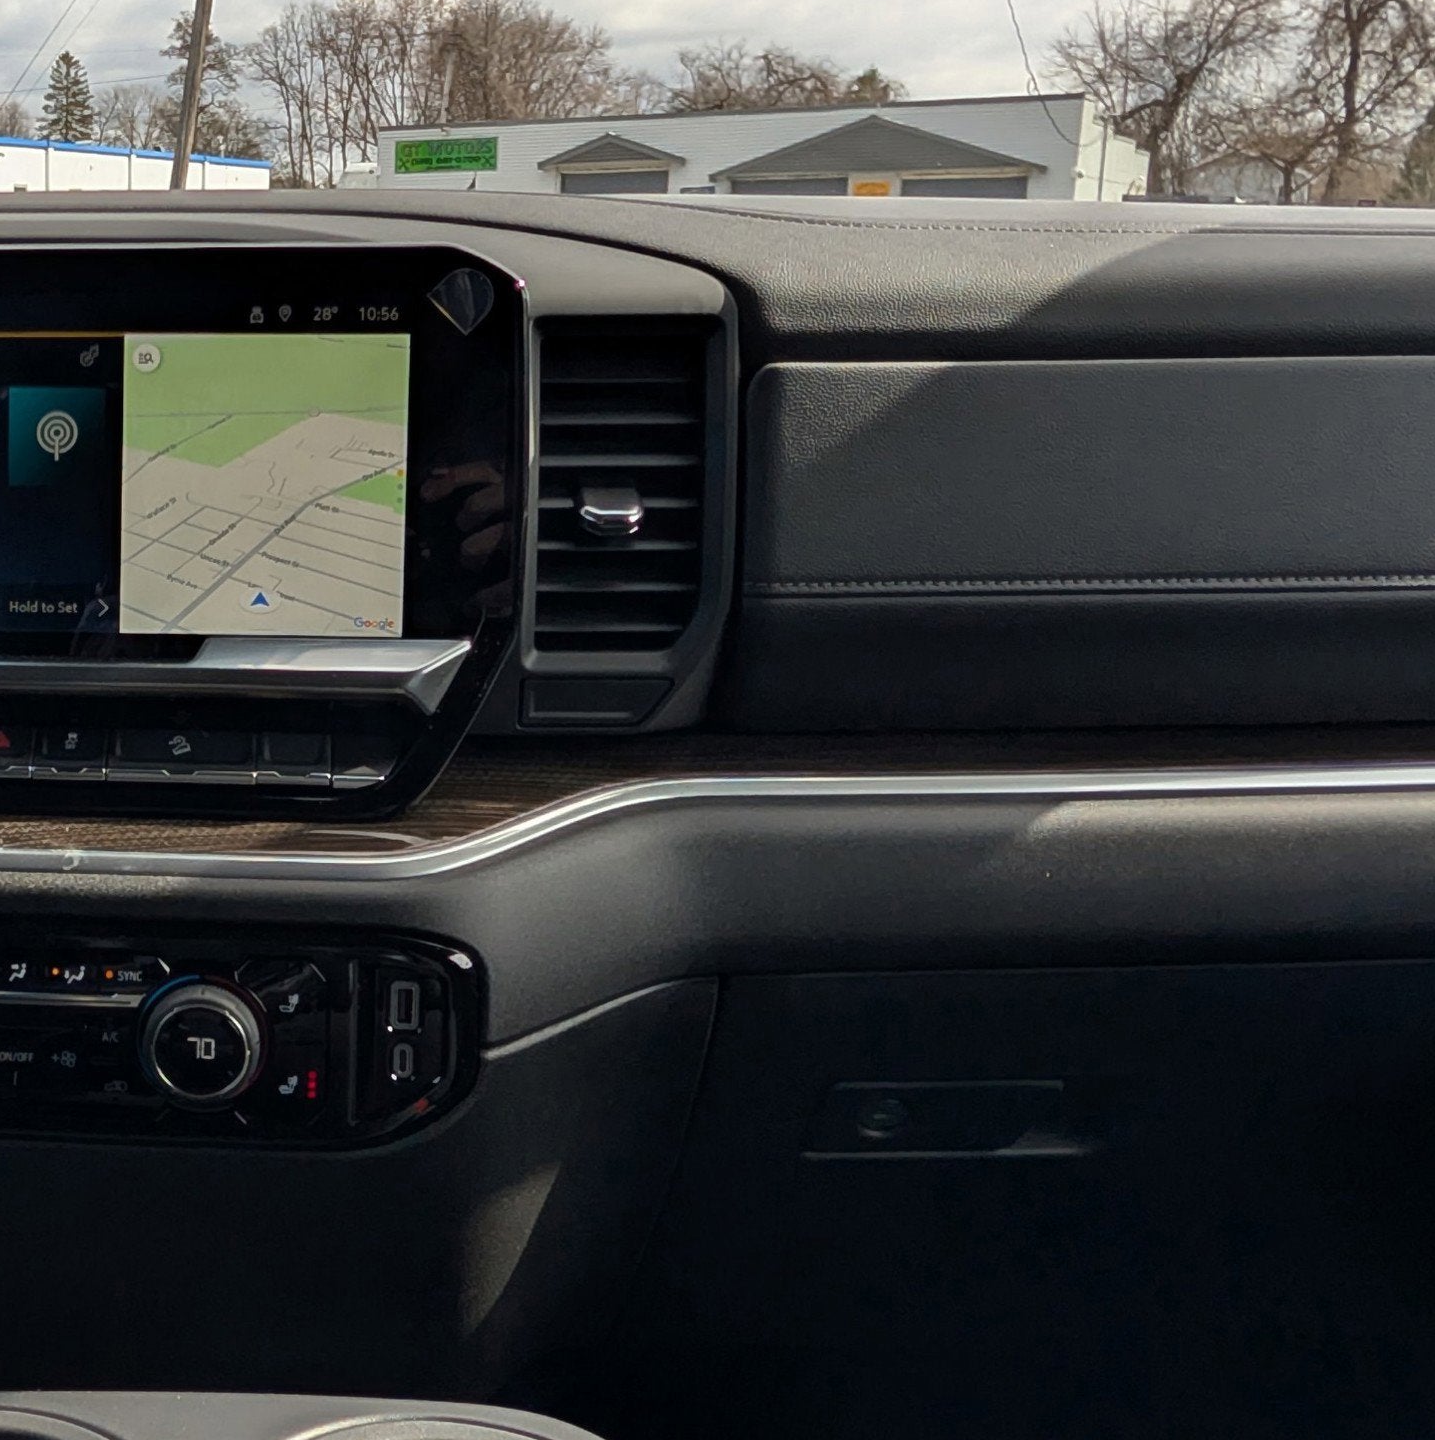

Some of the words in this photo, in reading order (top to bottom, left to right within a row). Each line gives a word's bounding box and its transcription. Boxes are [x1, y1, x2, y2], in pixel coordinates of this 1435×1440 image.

[358, 306, 399, 322] 10:56
[9, 599, 39, 615] Hold
[42, 601, 55, 615] to
[58, 599, 78, 615] Set
[354, 616, 395, 631] Google
[116, 968, 143, 983] SYNC
[186, 1037, 216, 1061] 70
